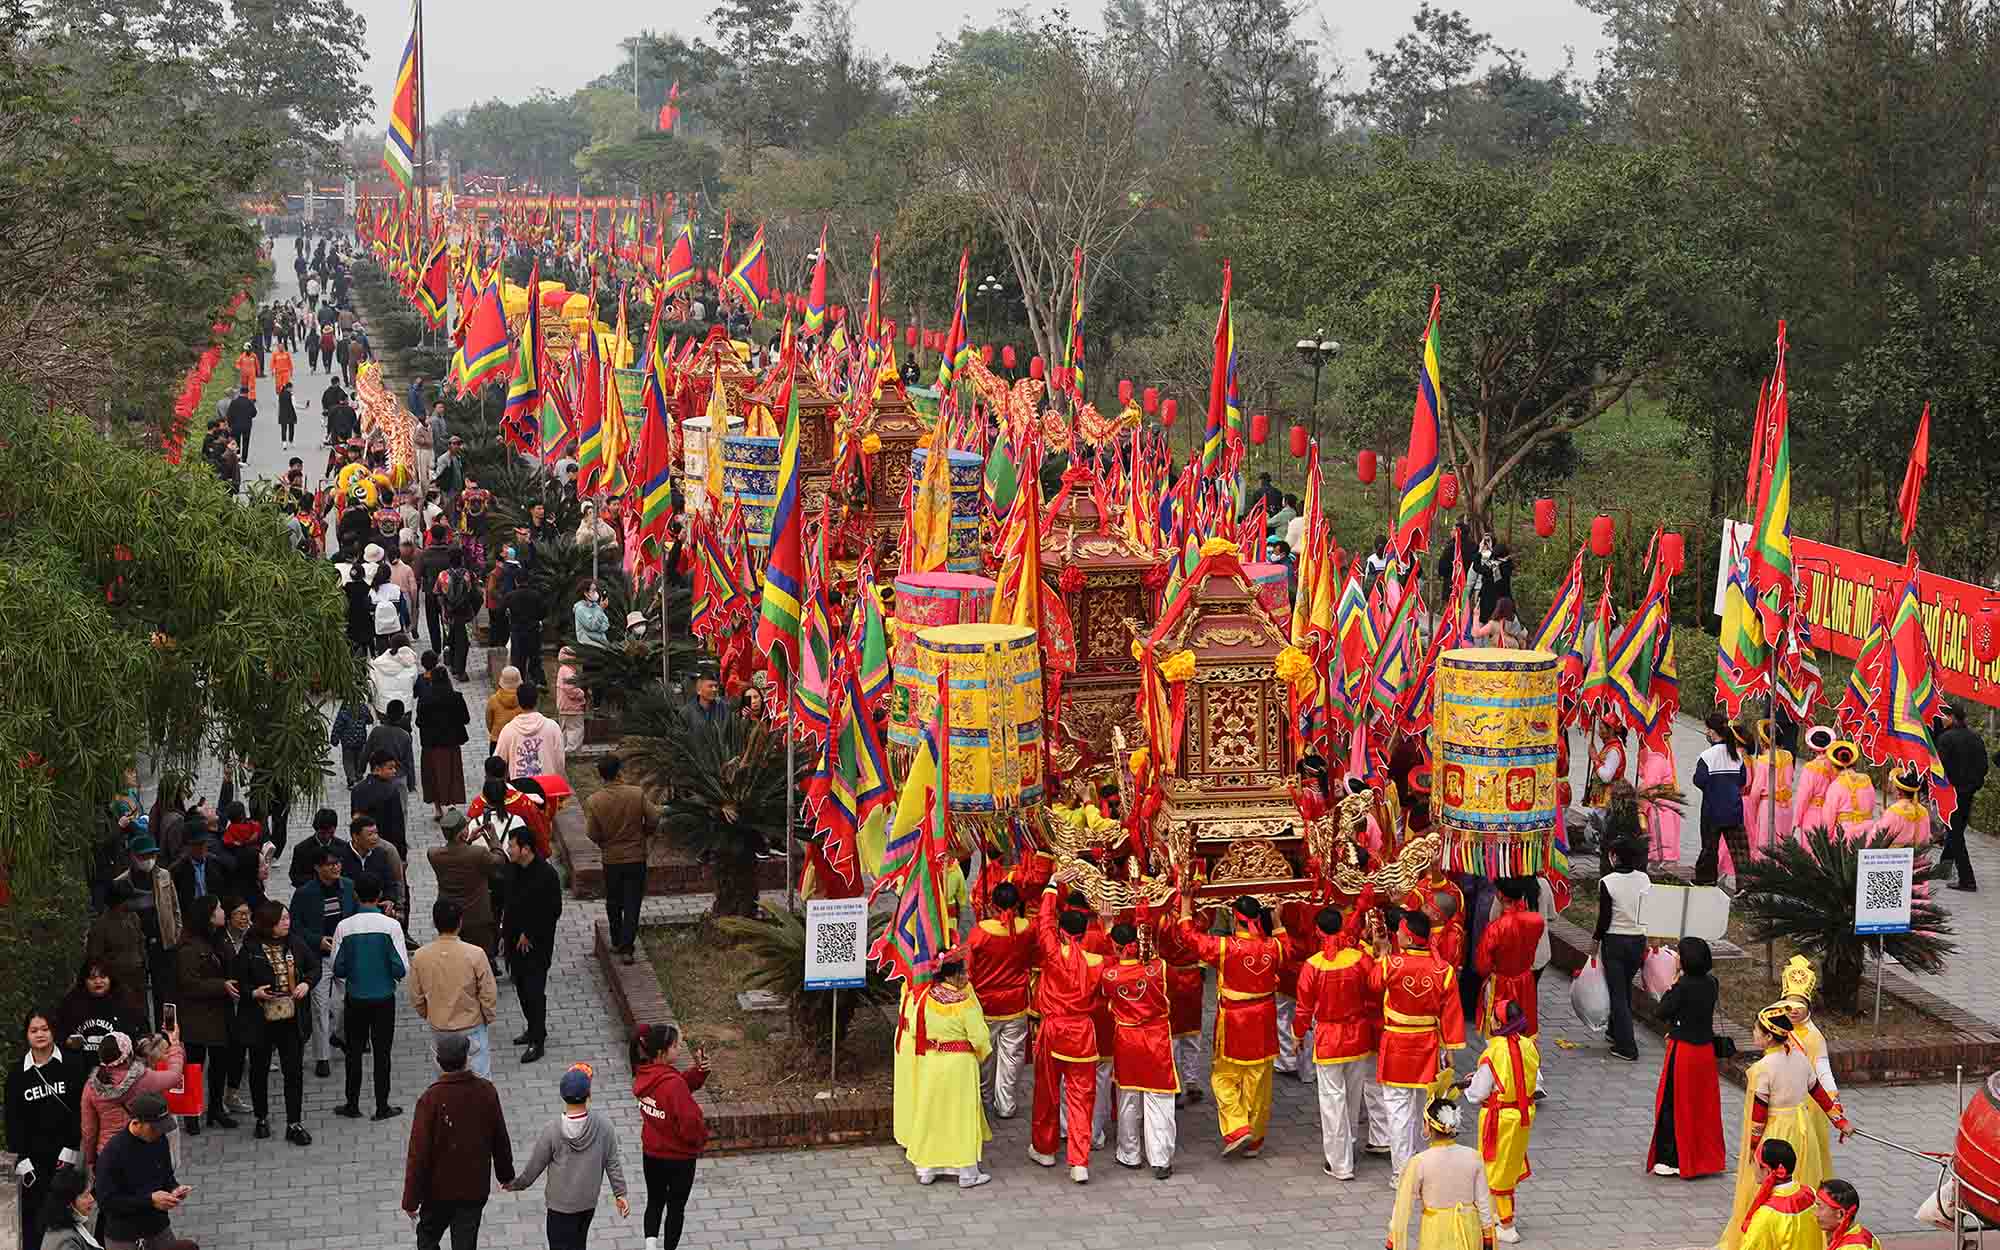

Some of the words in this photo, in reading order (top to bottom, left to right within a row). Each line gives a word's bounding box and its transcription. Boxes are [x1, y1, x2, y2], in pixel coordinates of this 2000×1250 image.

[1822, 563, 1855, 636] LĂNG
[1940, 599, 1968, 673] CÁC
[24, 1081, 66, 1101] CELINE
